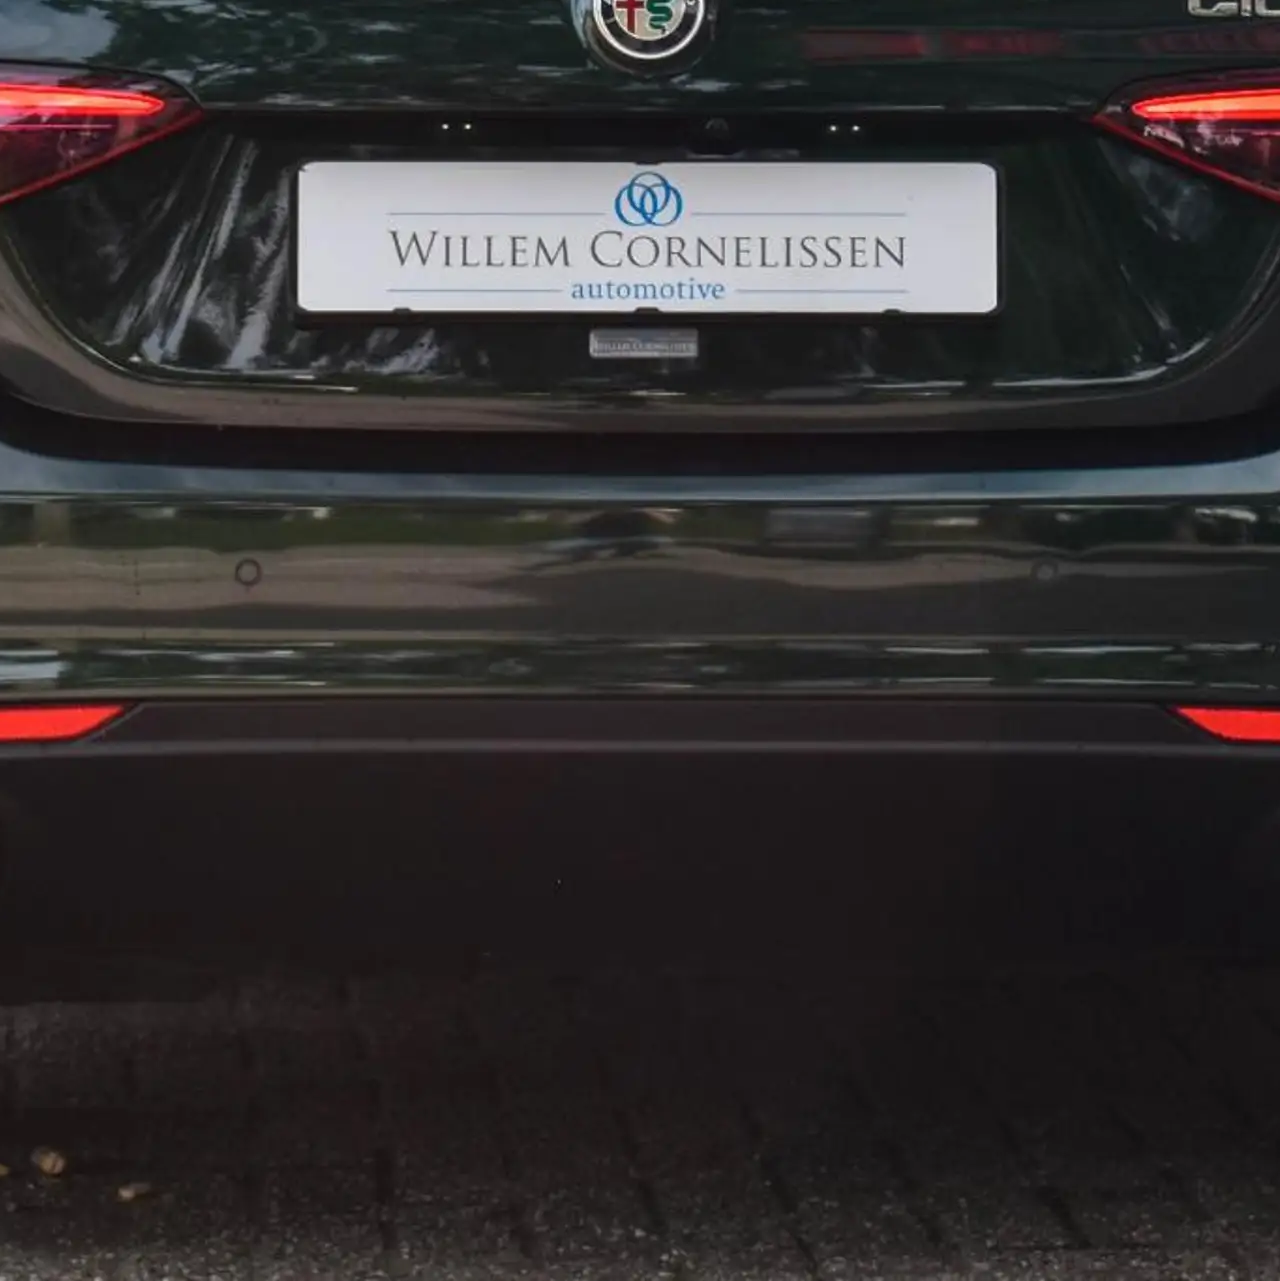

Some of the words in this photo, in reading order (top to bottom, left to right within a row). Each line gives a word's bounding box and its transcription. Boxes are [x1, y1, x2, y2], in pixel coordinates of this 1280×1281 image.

[390, 230, 570, 268] WILLEM
[589, 230, 907, 268] CORNELISSEN
[570, 279, 726, 301] automotive
